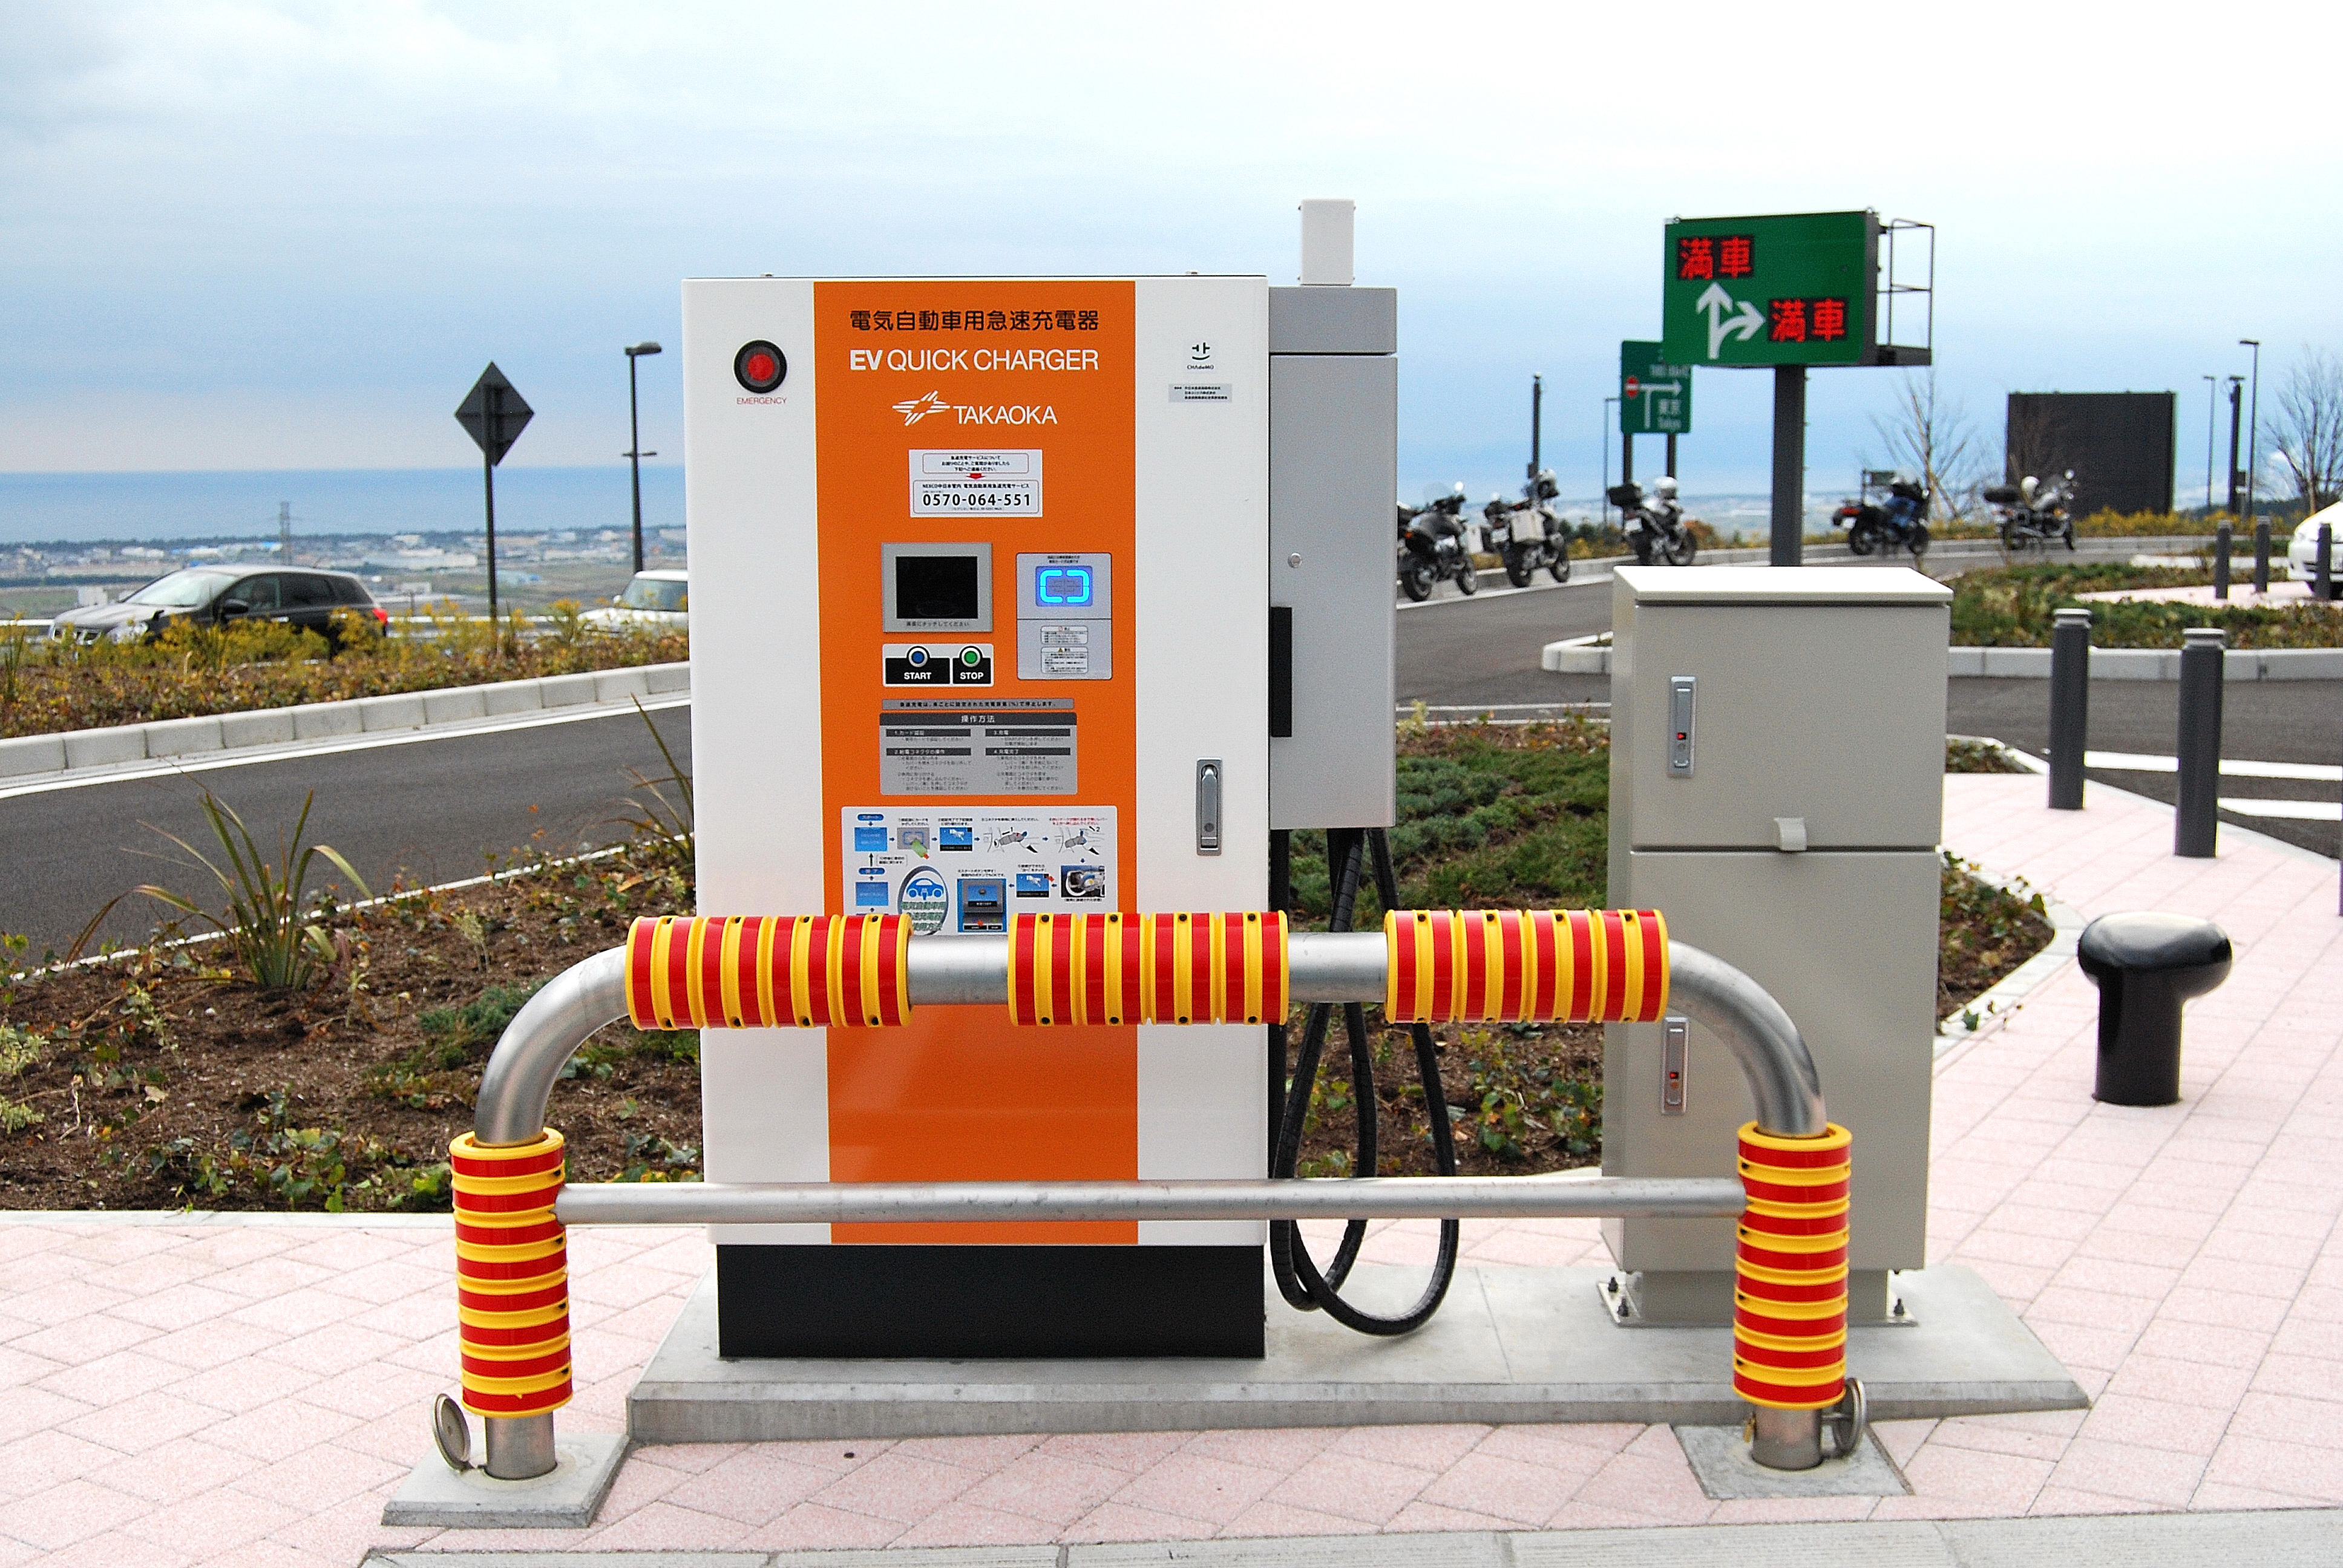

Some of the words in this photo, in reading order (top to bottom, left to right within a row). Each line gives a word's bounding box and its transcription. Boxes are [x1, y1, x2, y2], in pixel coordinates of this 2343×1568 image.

[1682, 236, 1752, 279] 満車
[850, 309, 1099, 331] 電気自動車用急速充電器
[1770, 298, 1846, 342] 満車
[850, 349, 883, 370] EV
[886, 348, 969, 371] QUICK
[973, 348, 1099, 371] CHARGER
[736, 396, 787, 405] EMERGENCY
[952, 405, 1058, 425] TAKAOKA
[923, 493, 1030, 506] 0570-064-551
[903, 671, 932, 680] START
[960, 671, 984, 680] STOP
[961, 714, 995, 723] 操作方法
